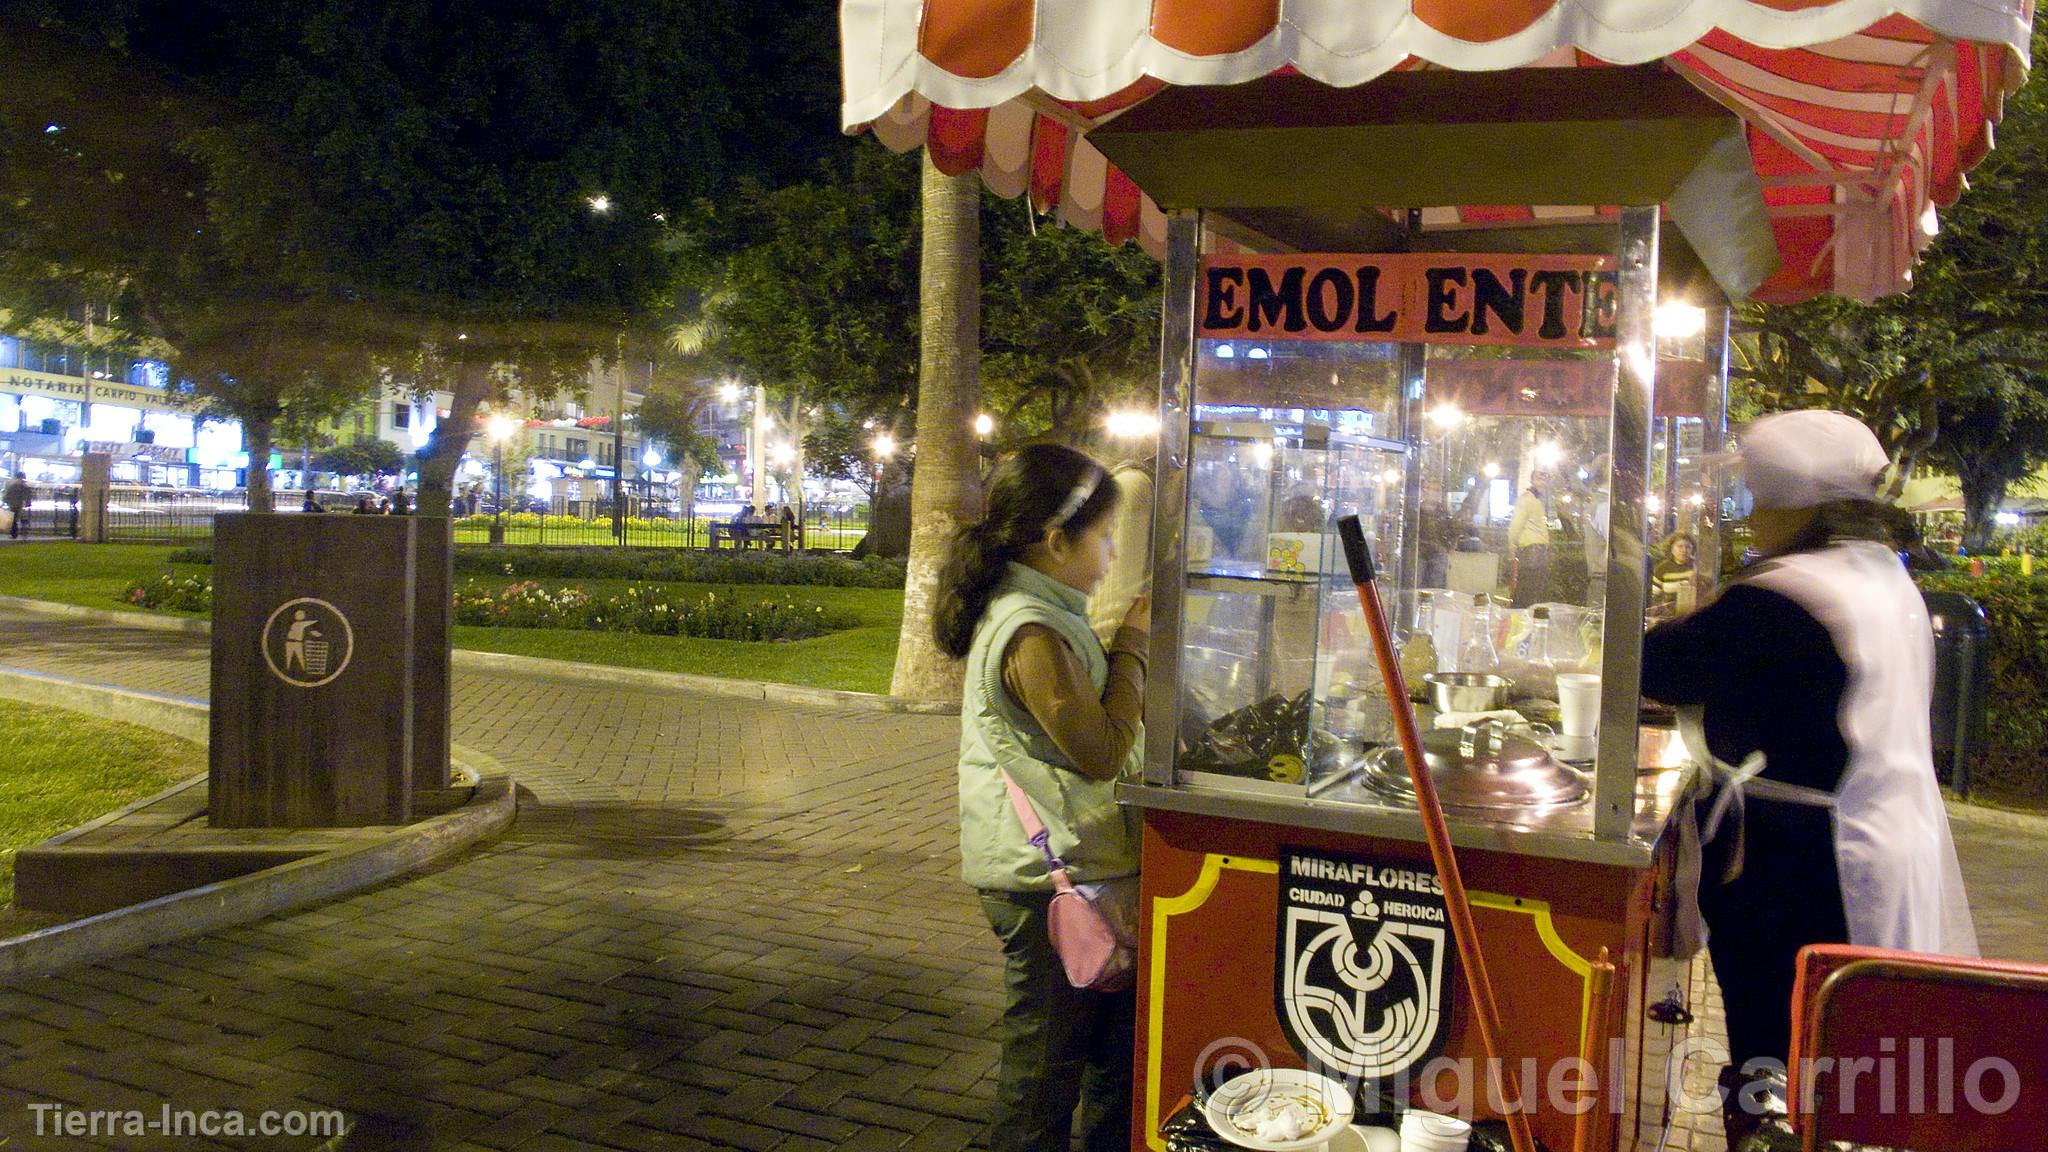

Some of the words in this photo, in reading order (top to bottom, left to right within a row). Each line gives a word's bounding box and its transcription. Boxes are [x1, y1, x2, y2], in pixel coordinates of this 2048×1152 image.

[10, 375, 86, 395] NOTARIA
[95, 386, 137, 401] CARPIO
[1290, 855, 1445, 896] MIRAFLORES
[1289, 887, 1345, 907] CIUDAD
[1383, 901, 1445, 922] HEROICA
